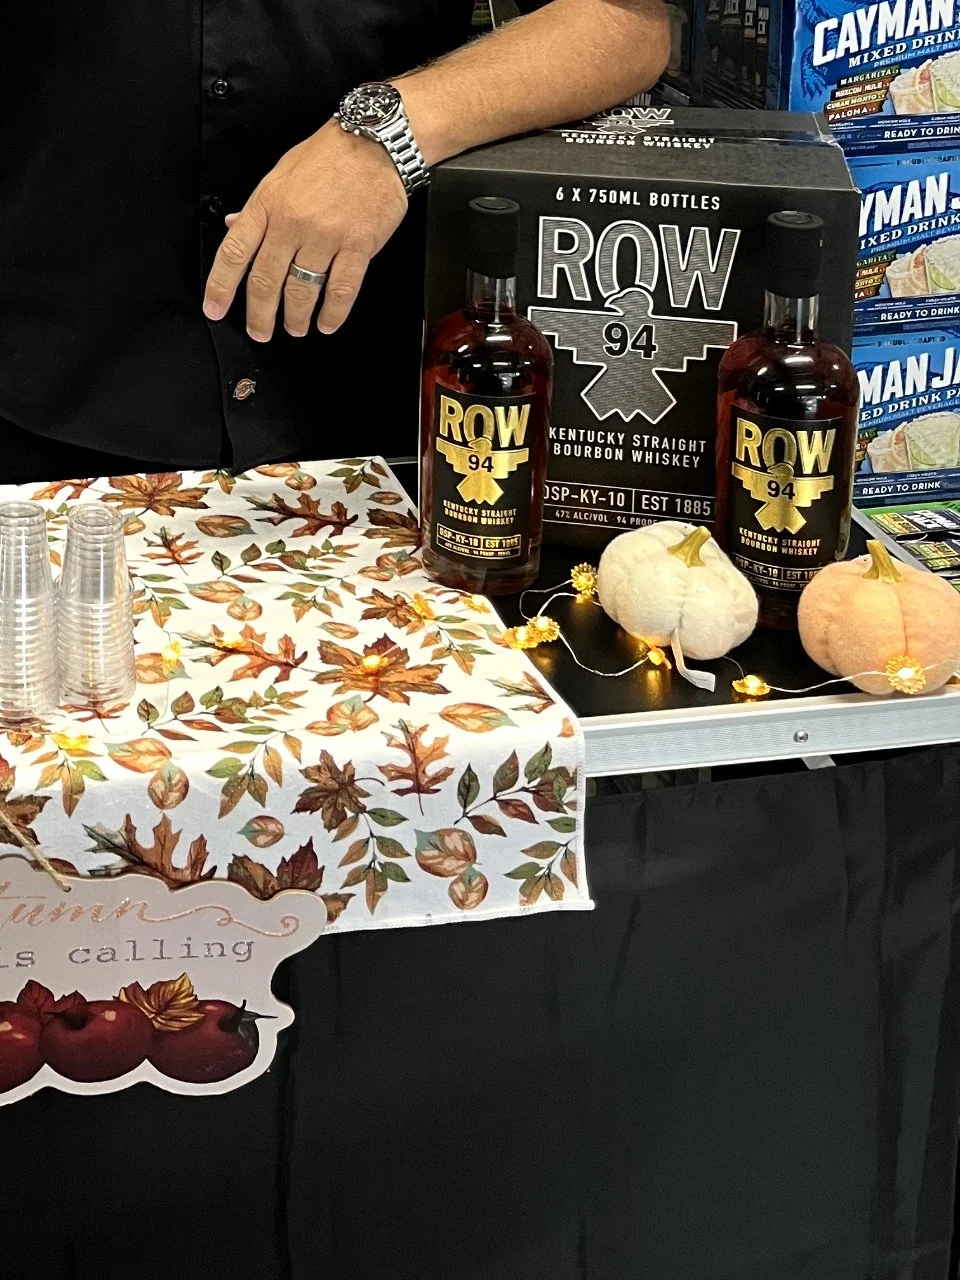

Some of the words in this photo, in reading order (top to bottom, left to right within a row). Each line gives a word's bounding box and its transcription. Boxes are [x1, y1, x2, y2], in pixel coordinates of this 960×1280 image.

[848, 43, 906, 68] MIXED
[840, 69, 892, 86] MARGARITA
[826, 99, 849, 110] CUBAN
[851, 94, 876, 105] MOJITO
[828, 106, 867, 121] PALOMA
[561, 132, 636, 141] KENTUCKY
[644, 135, 715, 144] STRAIGHT
[884, 128, 916, 139] READY
[921, 128, 933, 136] TO
[555, 186, 563, 201] 6
[572, 188, 581, 202] X
[589, 189, 640, 206] 750ML
[650, 193, 721, 210] BOTTLES
[860, 229, 902, 250] IXED
[907, 213, 960, 235] DRINK
[537, 216, 741, 311] ROW
[602, 322, 657, 359] 94
[440, 394, 531, 448] ROW
[549, 427, 625, 446] KENTUCKY
[633, 434, 707, 453] STRAIGHT
[736, 417, 836, 475] ROW
[553, 443, 623, 461] BOURBON
[632, 450, 700, 468] WHISKEY
[544, 485, 625, 507] DSP-KY-10
[641, 494, 669, 512] EST
[675, 498, 711, 516] 1885
[767, 480, 796, 500] 94
[862, 485, 894, 495] READY
[897, 484, 909, 492] TO
[912, 481, 940, 490] DRINK
[741, 536, 777, 553] BOURBON
[781, 547, 818, 556] WHISKEY
[68, 936, 254, 966] calling
